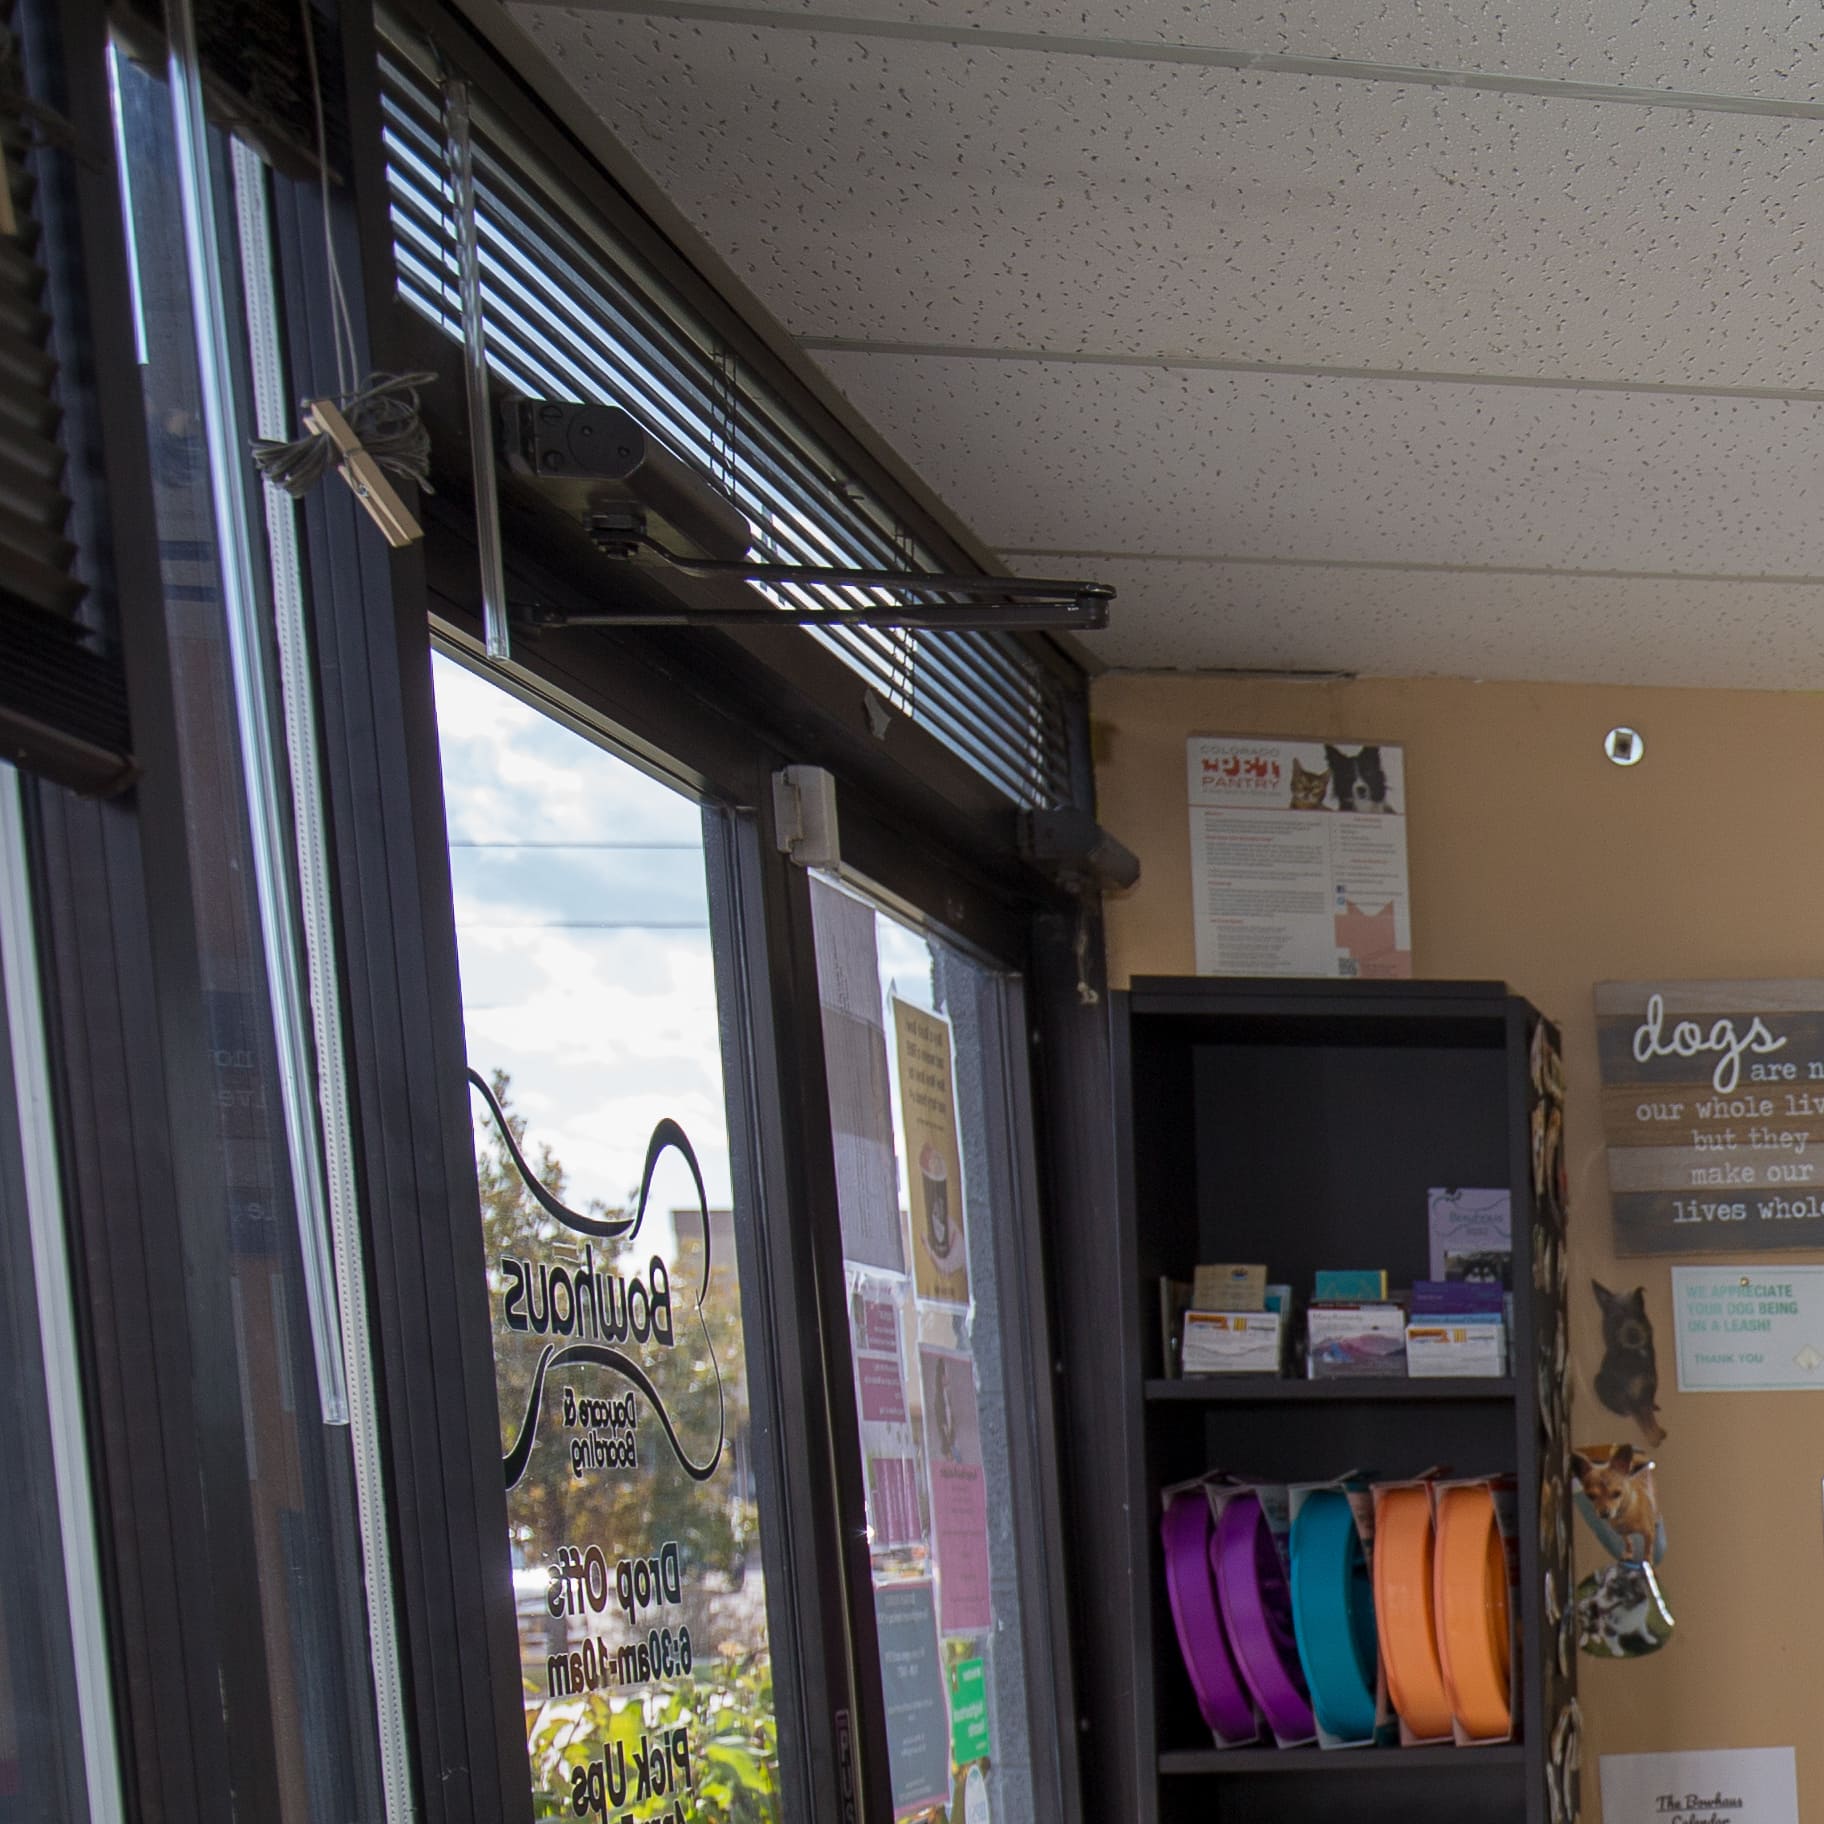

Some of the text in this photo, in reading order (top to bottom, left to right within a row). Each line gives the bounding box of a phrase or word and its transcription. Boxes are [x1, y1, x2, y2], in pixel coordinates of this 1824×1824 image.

[1201, 776, 1281, 791] PANTRY
[1632, 993, 1787, 1094] dogs
[1751, 1062, 1797, 1081] are
[1635, 1101, 1685, 1121] our
[1696, 1096, 1774, 1119] whole
[1691, 1127, 1810, 1154] but they
[1689, 1162, 1815, 1184] make our
[1673, 1200, 1746, 1223] lives
[1711, 1284, 1794, 1298] APPRECIATE
[1687, 1301, 1799, 1316] YOUR DOG BEING
[1688, 1319, 1772, 1333] ON A LEASH!
[1694, 1353, 1765, 1364] THANK YOU
[1656, 1795, 1682, 1813] The
